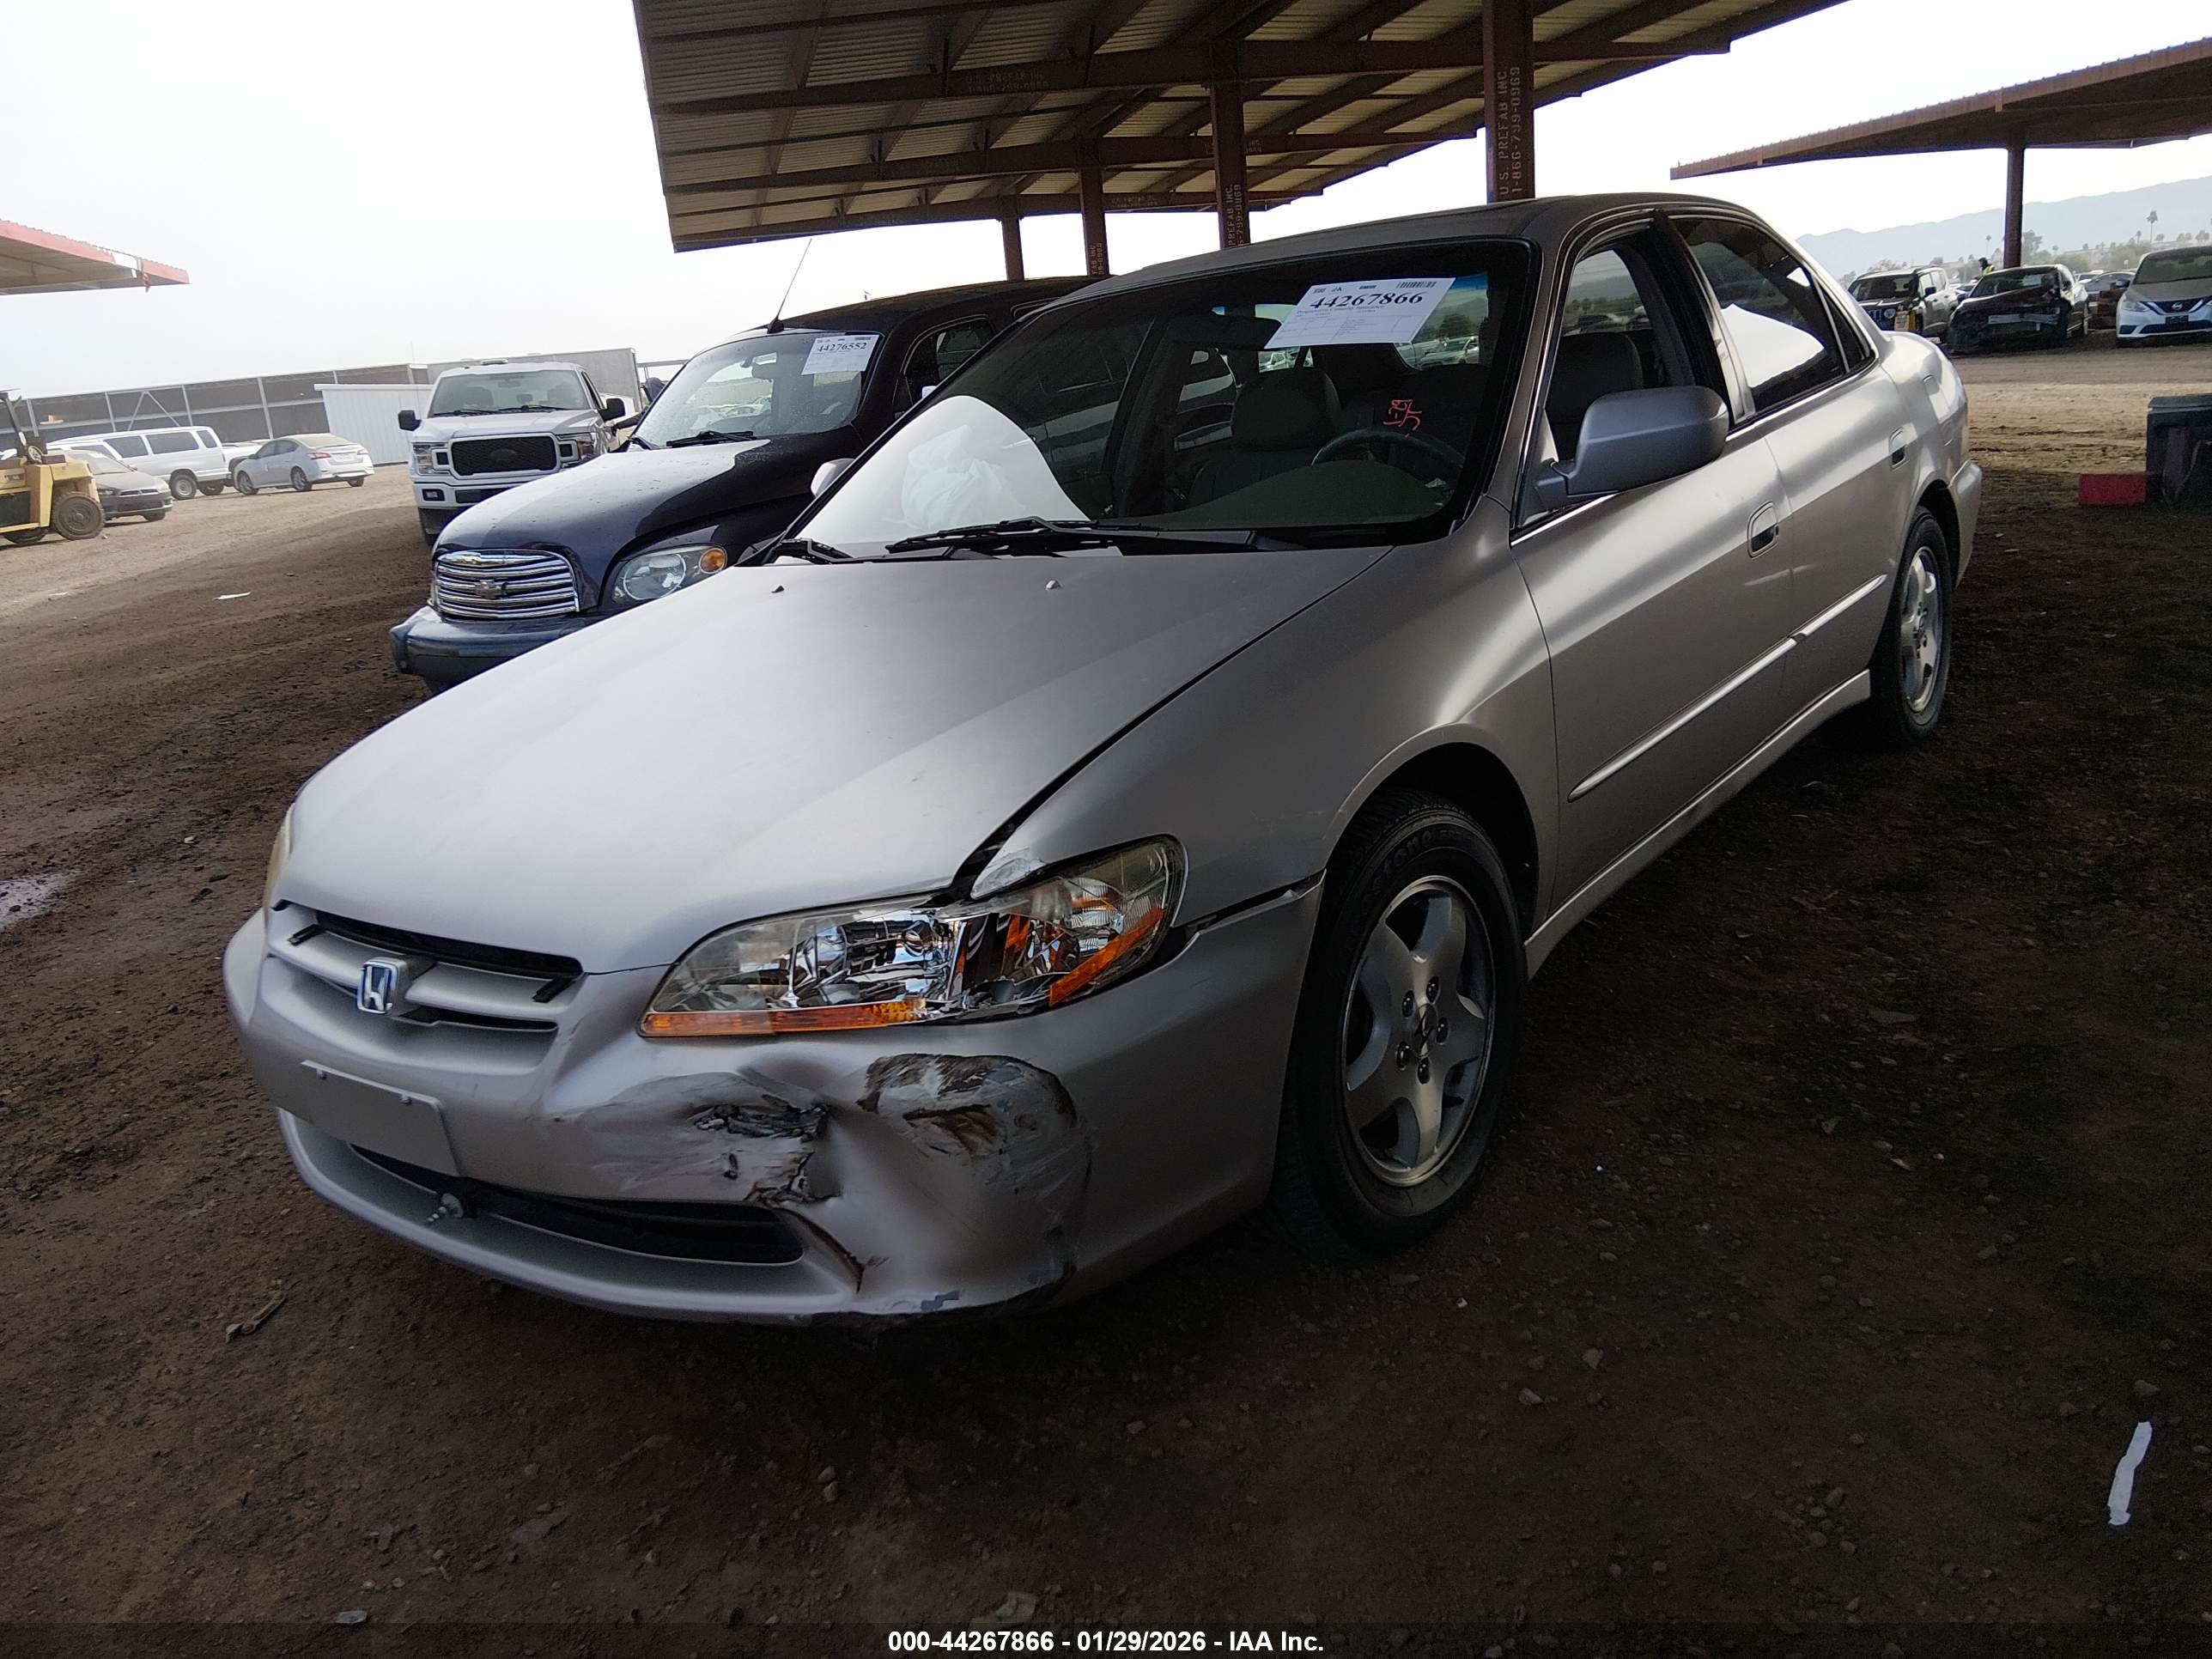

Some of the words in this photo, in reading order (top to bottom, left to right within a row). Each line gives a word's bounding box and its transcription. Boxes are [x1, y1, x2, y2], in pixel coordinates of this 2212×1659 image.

[1497, 103, 1509, 160] PREFAB
[1310, 291, 1427, 309] 44267866
[817, 342, 868, 352] 44276552
